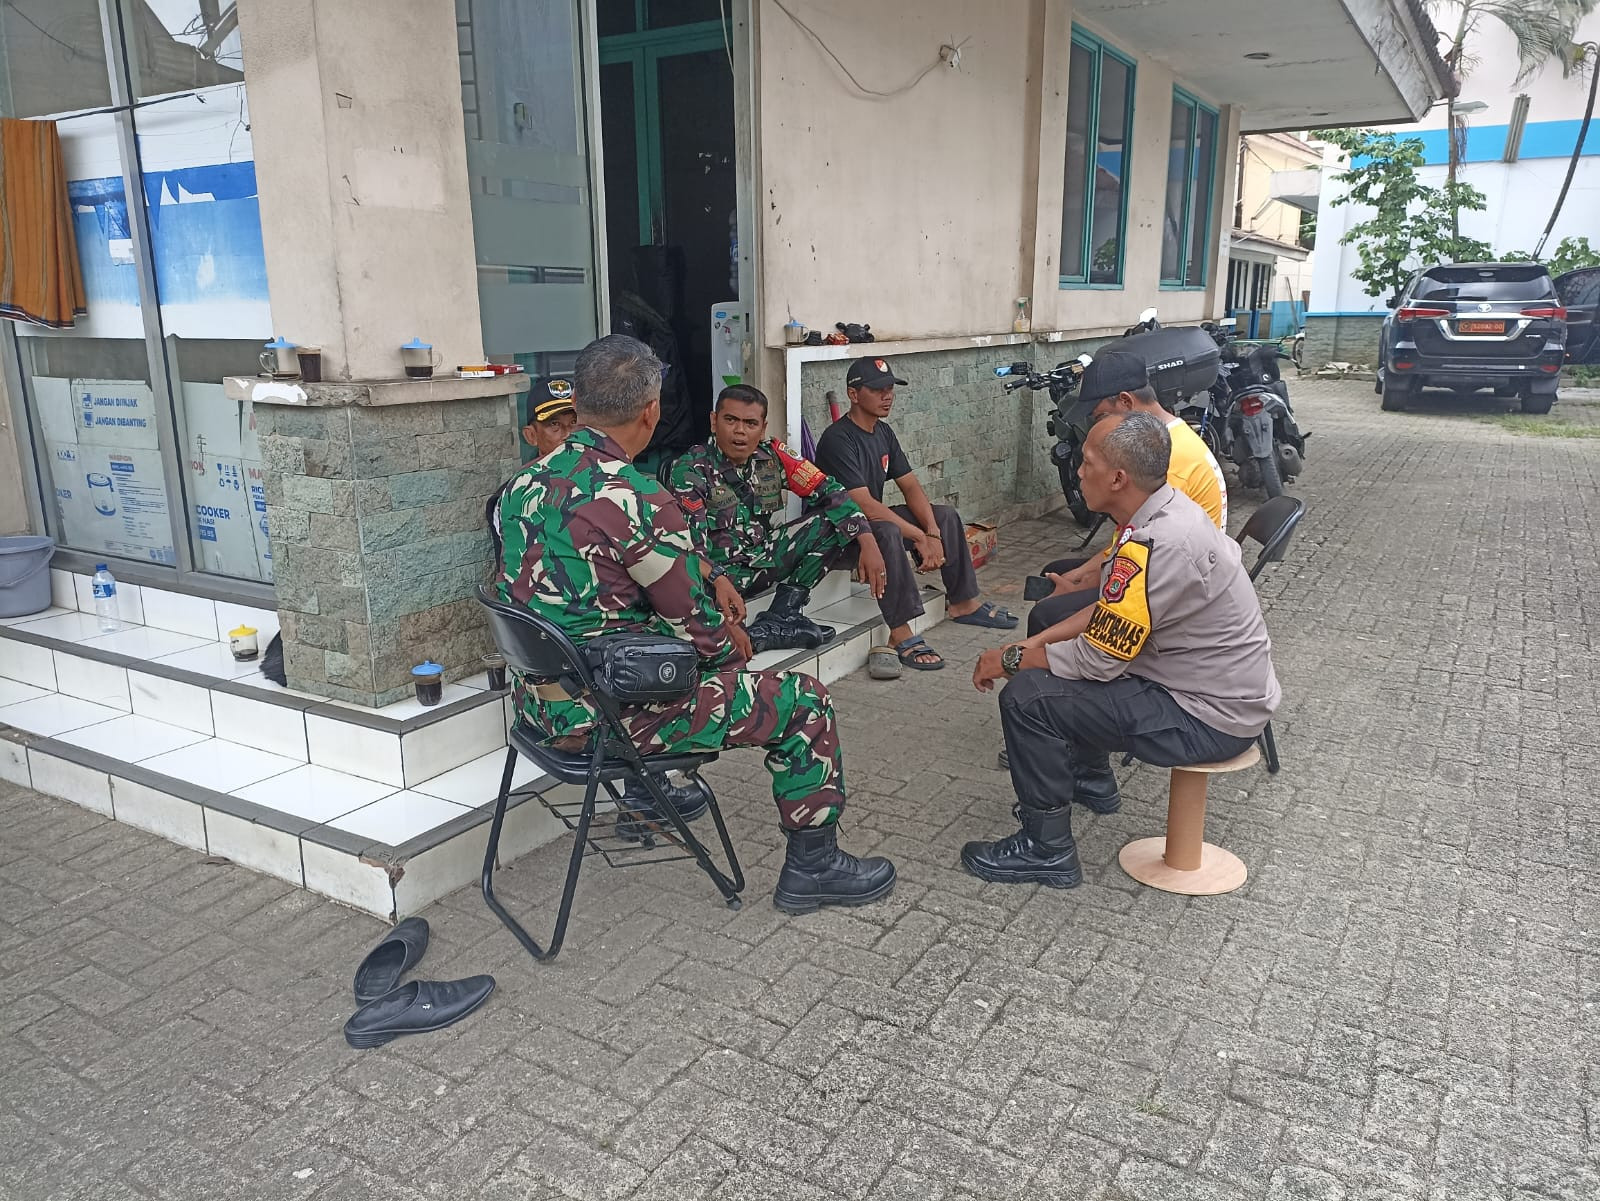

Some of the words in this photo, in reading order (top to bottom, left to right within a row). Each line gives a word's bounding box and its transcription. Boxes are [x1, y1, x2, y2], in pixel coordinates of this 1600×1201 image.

[1158, 360, 1184, 370] SHAD
[94, 397, 115, 406] JANGAN
[95, 416, 117, 426] JANGAN
[117, 418, 147, 428] DIBANTING
[195, 505, 231, 520] COOKER
